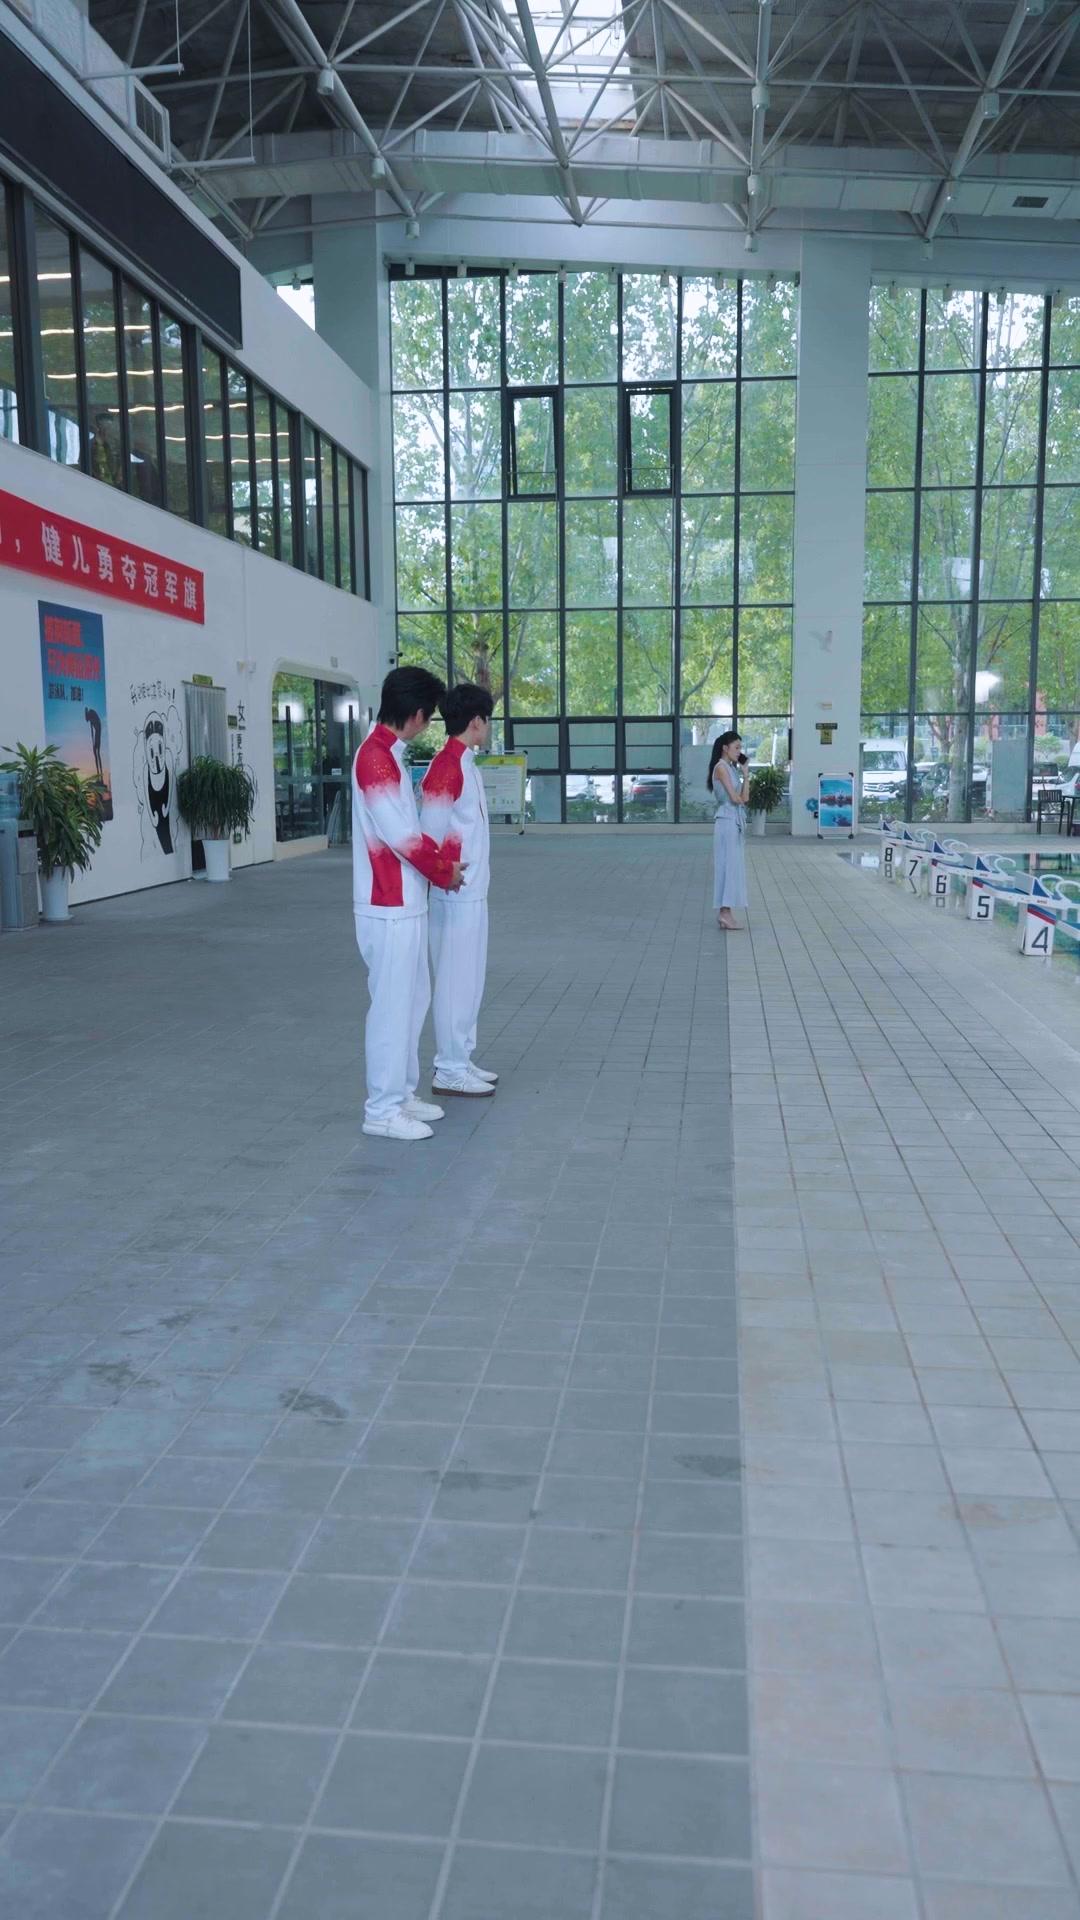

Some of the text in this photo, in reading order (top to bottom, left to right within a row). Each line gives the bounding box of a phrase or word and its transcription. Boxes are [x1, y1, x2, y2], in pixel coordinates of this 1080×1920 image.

[0, 520, 198, 611] ，健儿勇夺冠军旗
[884, 847, 893, 862] 8
[909, 860, 918, 876] 7
[936, 875, 946, 894] 6
[977, 896, 990, 918] 5
[1031, 926, 1049, 954] 4
